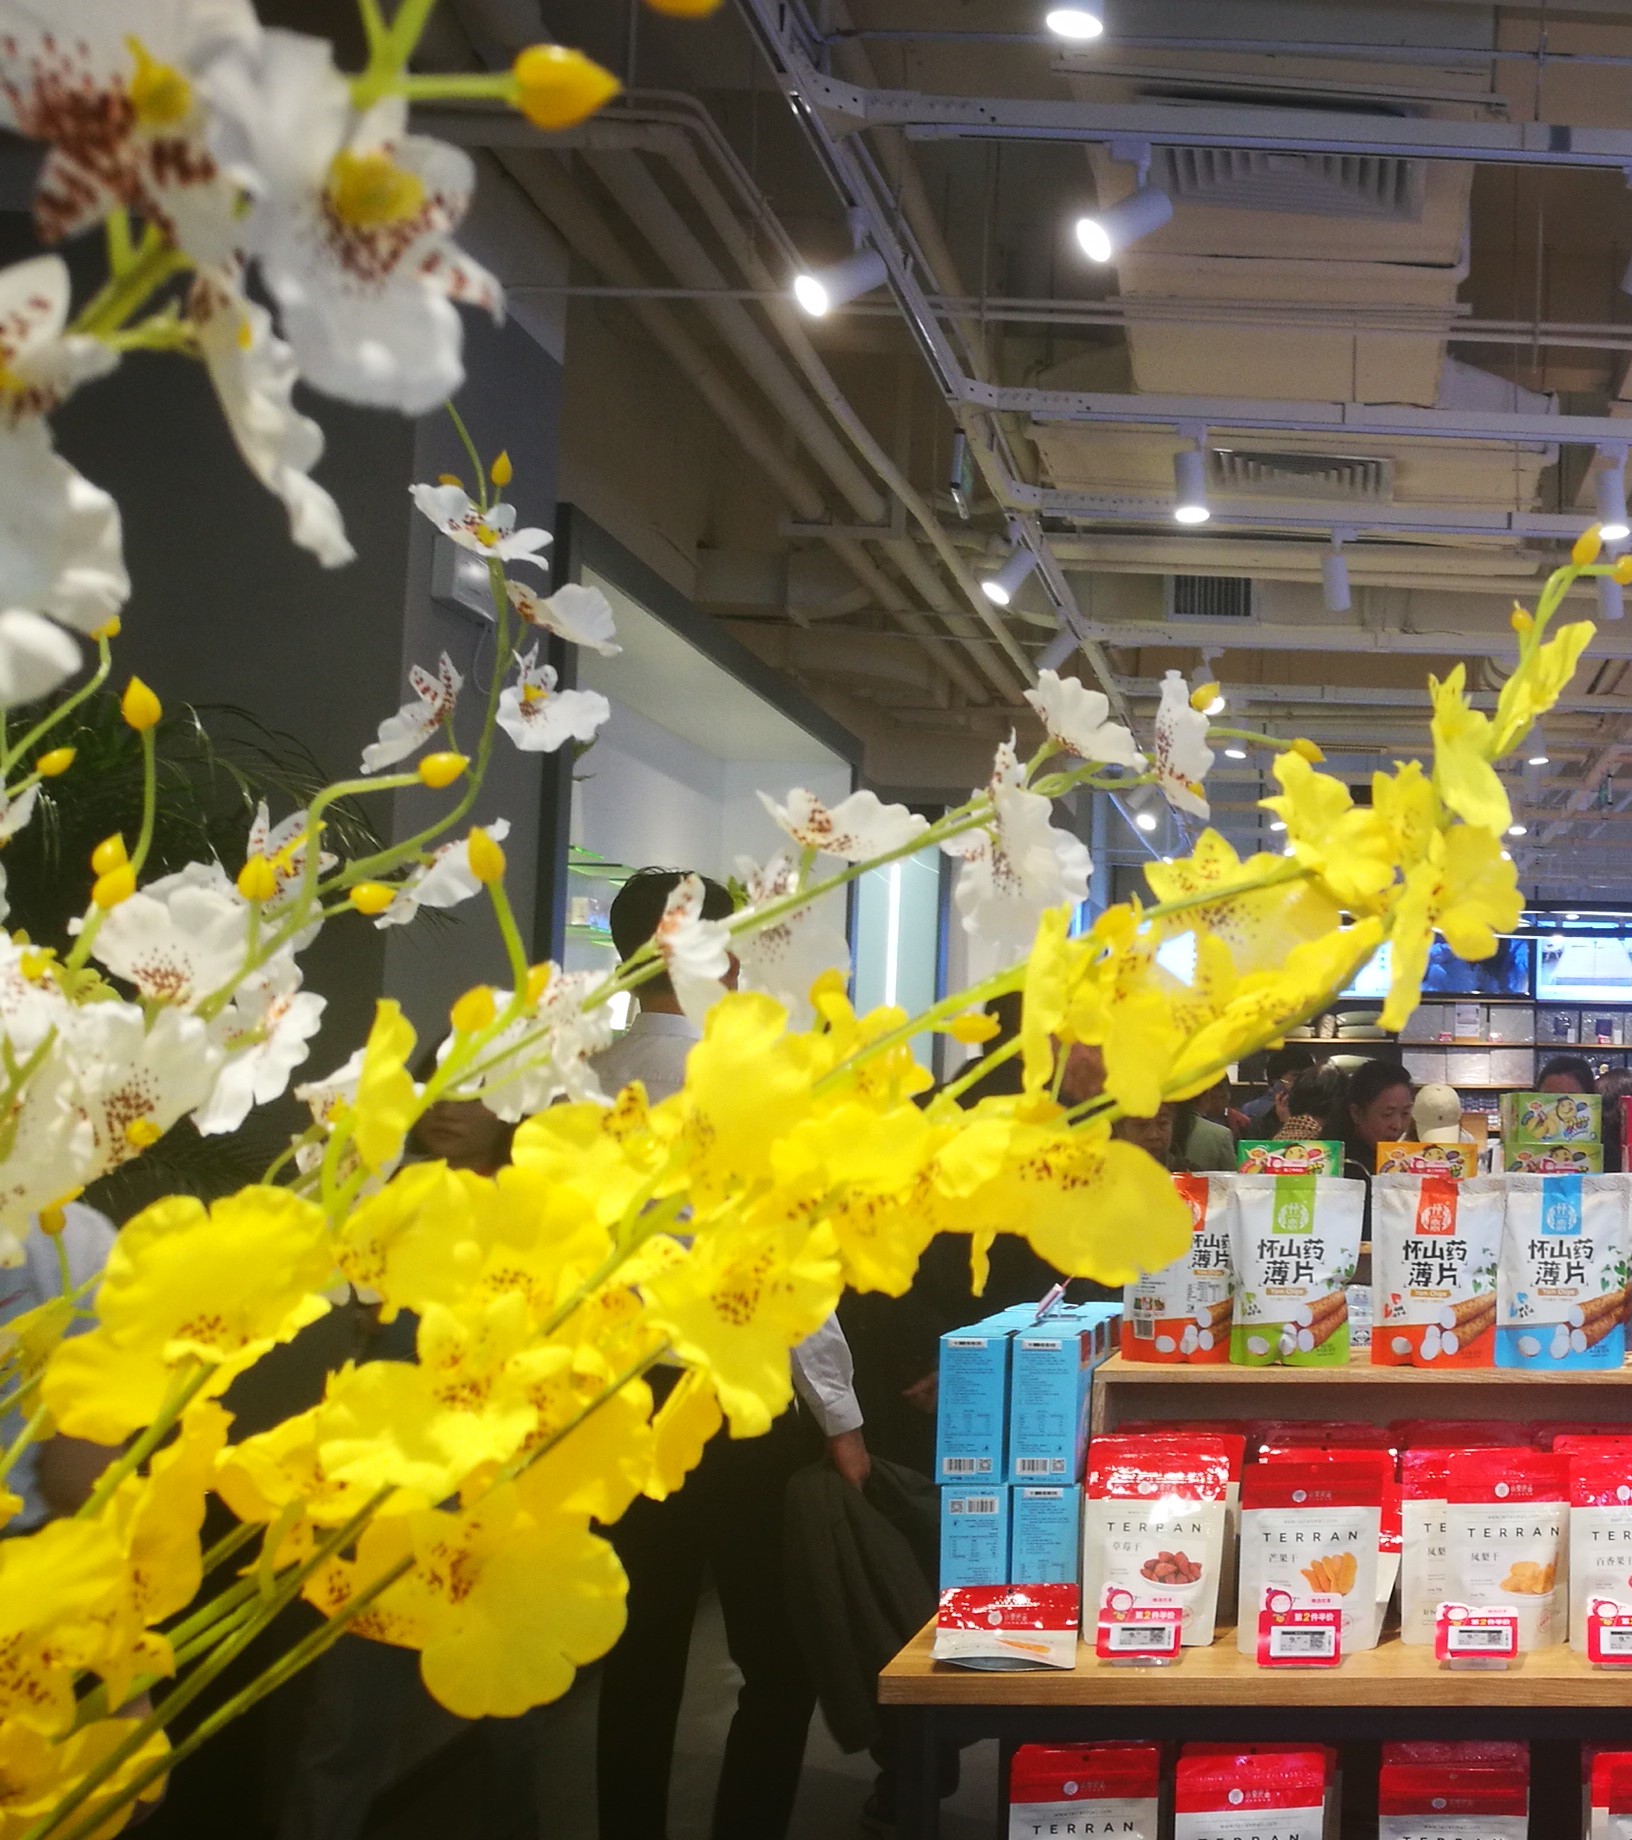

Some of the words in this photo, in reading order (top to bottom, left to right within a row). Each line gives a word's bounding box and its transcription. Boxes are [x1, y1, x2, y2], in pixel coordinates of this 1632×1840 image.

[1257, 1239, 1325, 1260] 怀山药
[1403, 1240, 1467, 1262] 怀山药
[1528, 1239, 1593, 1260] 怀山药
[1191, 1250, 1229, 1269] 薄片
[1263, 1261, 1316, 1285] 薄片
[1408, 1262, 1458, 1287] 薄片
[1535, 1262, 1586, 1286] 薄片
[1107, 1522, 1201, 1532] TERRAN
[1468, 1527, 1560, 1537] TERRAN
[1263, 1531, 1358, 1542] TERRAN
[1269, 1553, 1299, 1563] 芒果干
[1135, 1611, 1175, 1620] 第2件半价
[1294, 1613, 1335, 1622] 第2件半价
[1032, 1821, 1134, 1835] TERRAN
